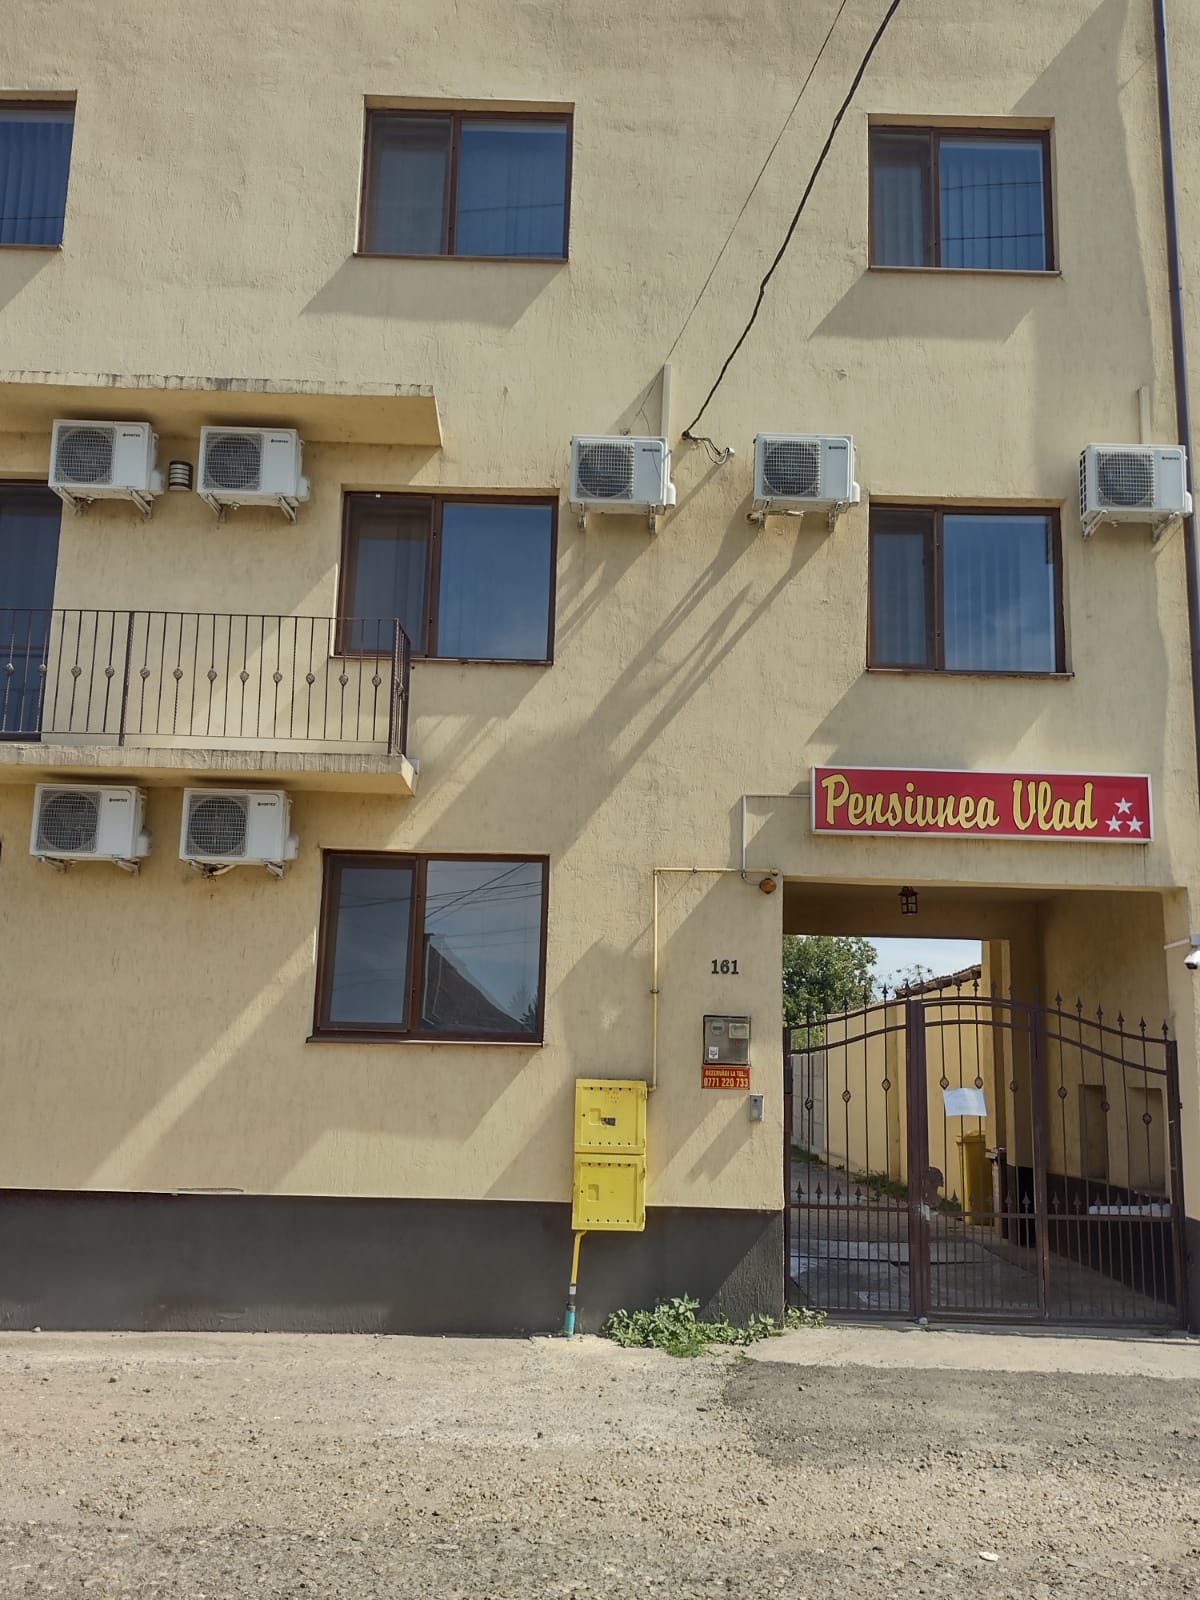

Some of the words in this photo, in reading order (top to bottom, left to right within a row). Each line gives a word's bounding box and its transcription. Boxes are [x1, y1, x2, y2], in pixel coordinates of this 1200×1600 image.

[821, 774, 1000, 829] Pensiunea
[1012, 779, 1098, 831] Vlad
[711, 959, 740, 975] 161
[703, 1077, 719, 1087] 0771
[721, 1077, 734, 1087] 220
[736, 1078, 748, 1087] 733
